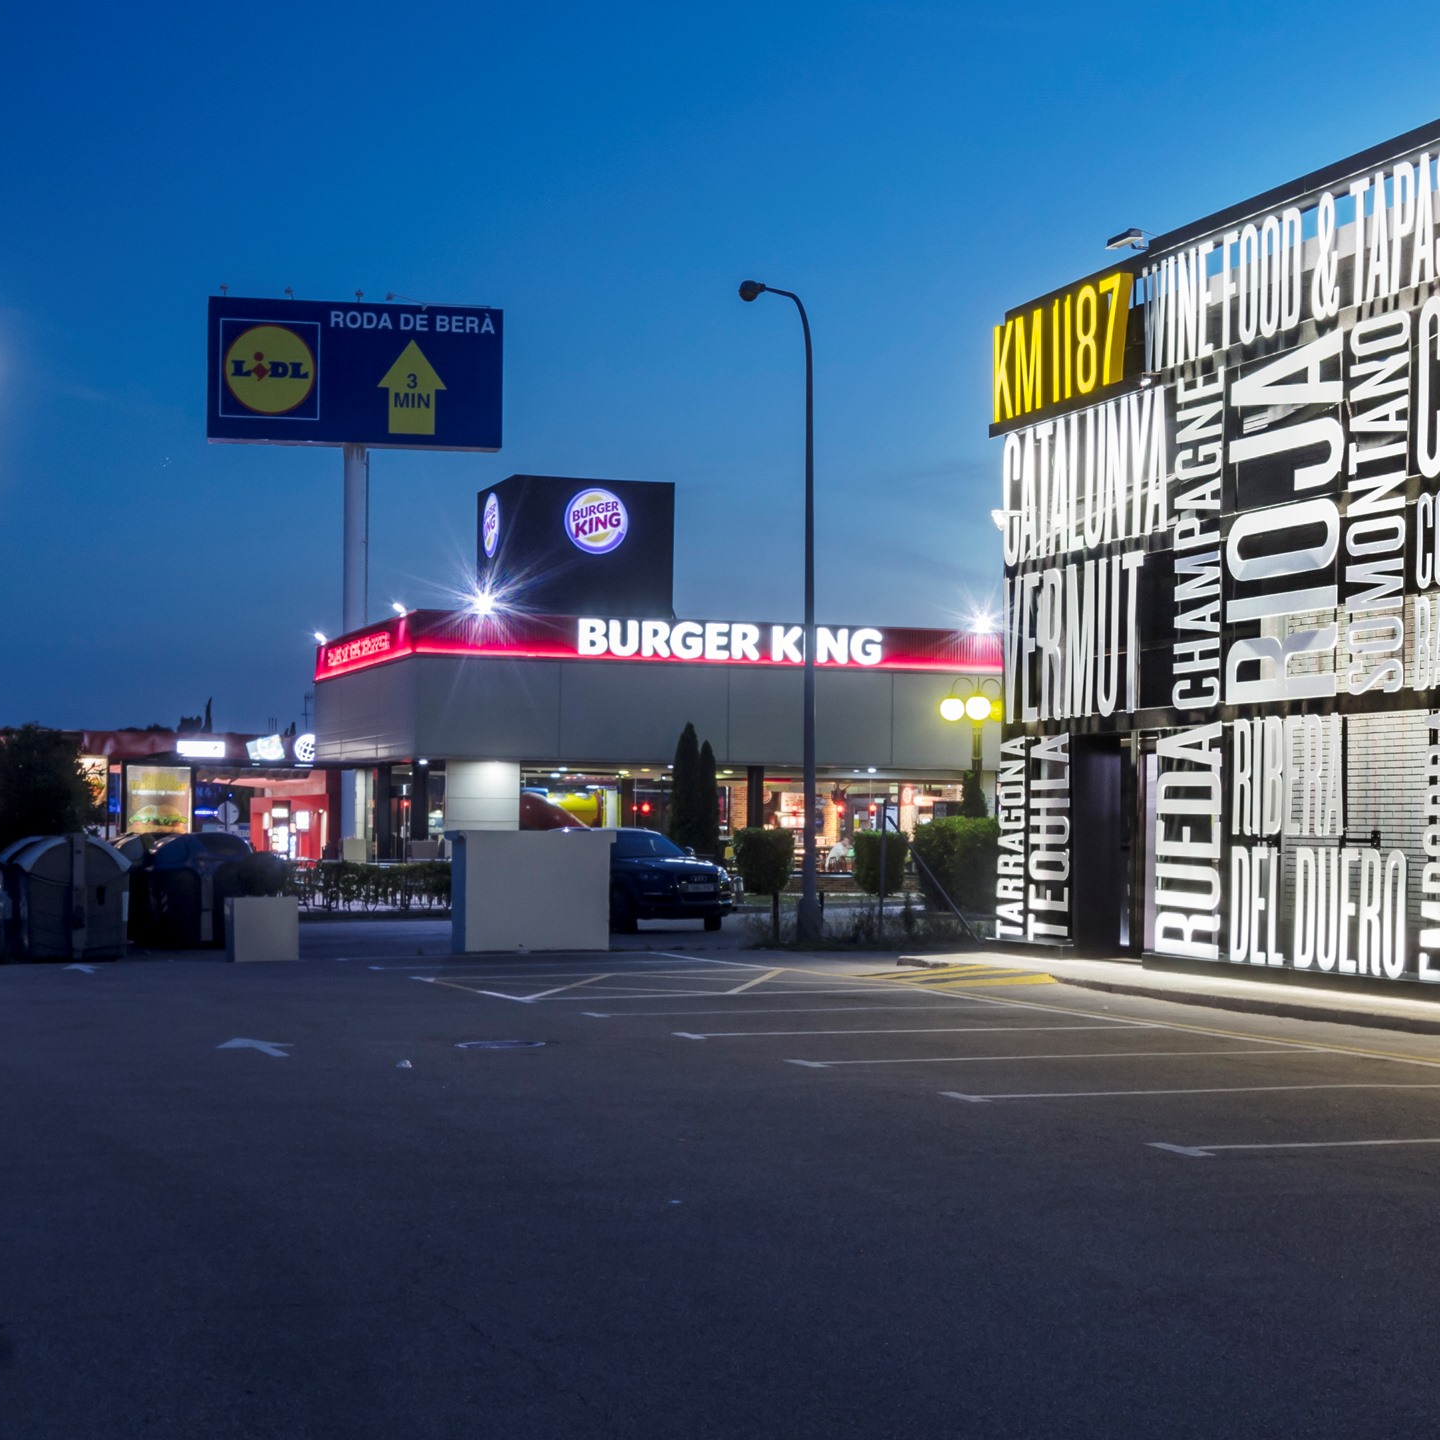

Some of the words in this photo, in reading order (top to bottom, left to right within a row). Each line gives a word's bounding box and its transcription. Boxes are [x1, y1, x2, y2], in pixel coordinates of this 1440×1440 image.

[330, 310, 393, 330] RODA
[400, 314, 428, 332] DE
[435, 313, 496, 334] BERÀ
[1142, 239, 1215, 374] WINE
[1221, 206, 1303, 351] FOOD
[1311, 191, 1341, 321] &
[393, 391, 431, 410] MIN
[406, 373, 418, 389] 3
[993, 308, 1042, 424] KM
[572, 501, 619, 522] BURGER
[574, 512, 621, 539] KING
[1001, 387, 1167, 567] CATALUNYA
[1172, 365, 1227, 710] CHAMPAGNE
[1225, 326, 1344, 705] RIOJA
[1342, 311, 1411, 696] SOMONTANO
[578, 617, 760, 661] BURGER
[771, 624, 883, 666] KNG
[1004, 550, 1144, 724] VERMUT
[994, 733, 1026, 940] TARRAGONA
[1027, 731, 1071, 942] TEQUILA
[1154, 719, 1224, 960] RUEDA
[1230, 712, 1344, 837] RIBERA
[1229, 853, 1285, 965] DEL
[1291, 846, 1409, 980] DUERO
